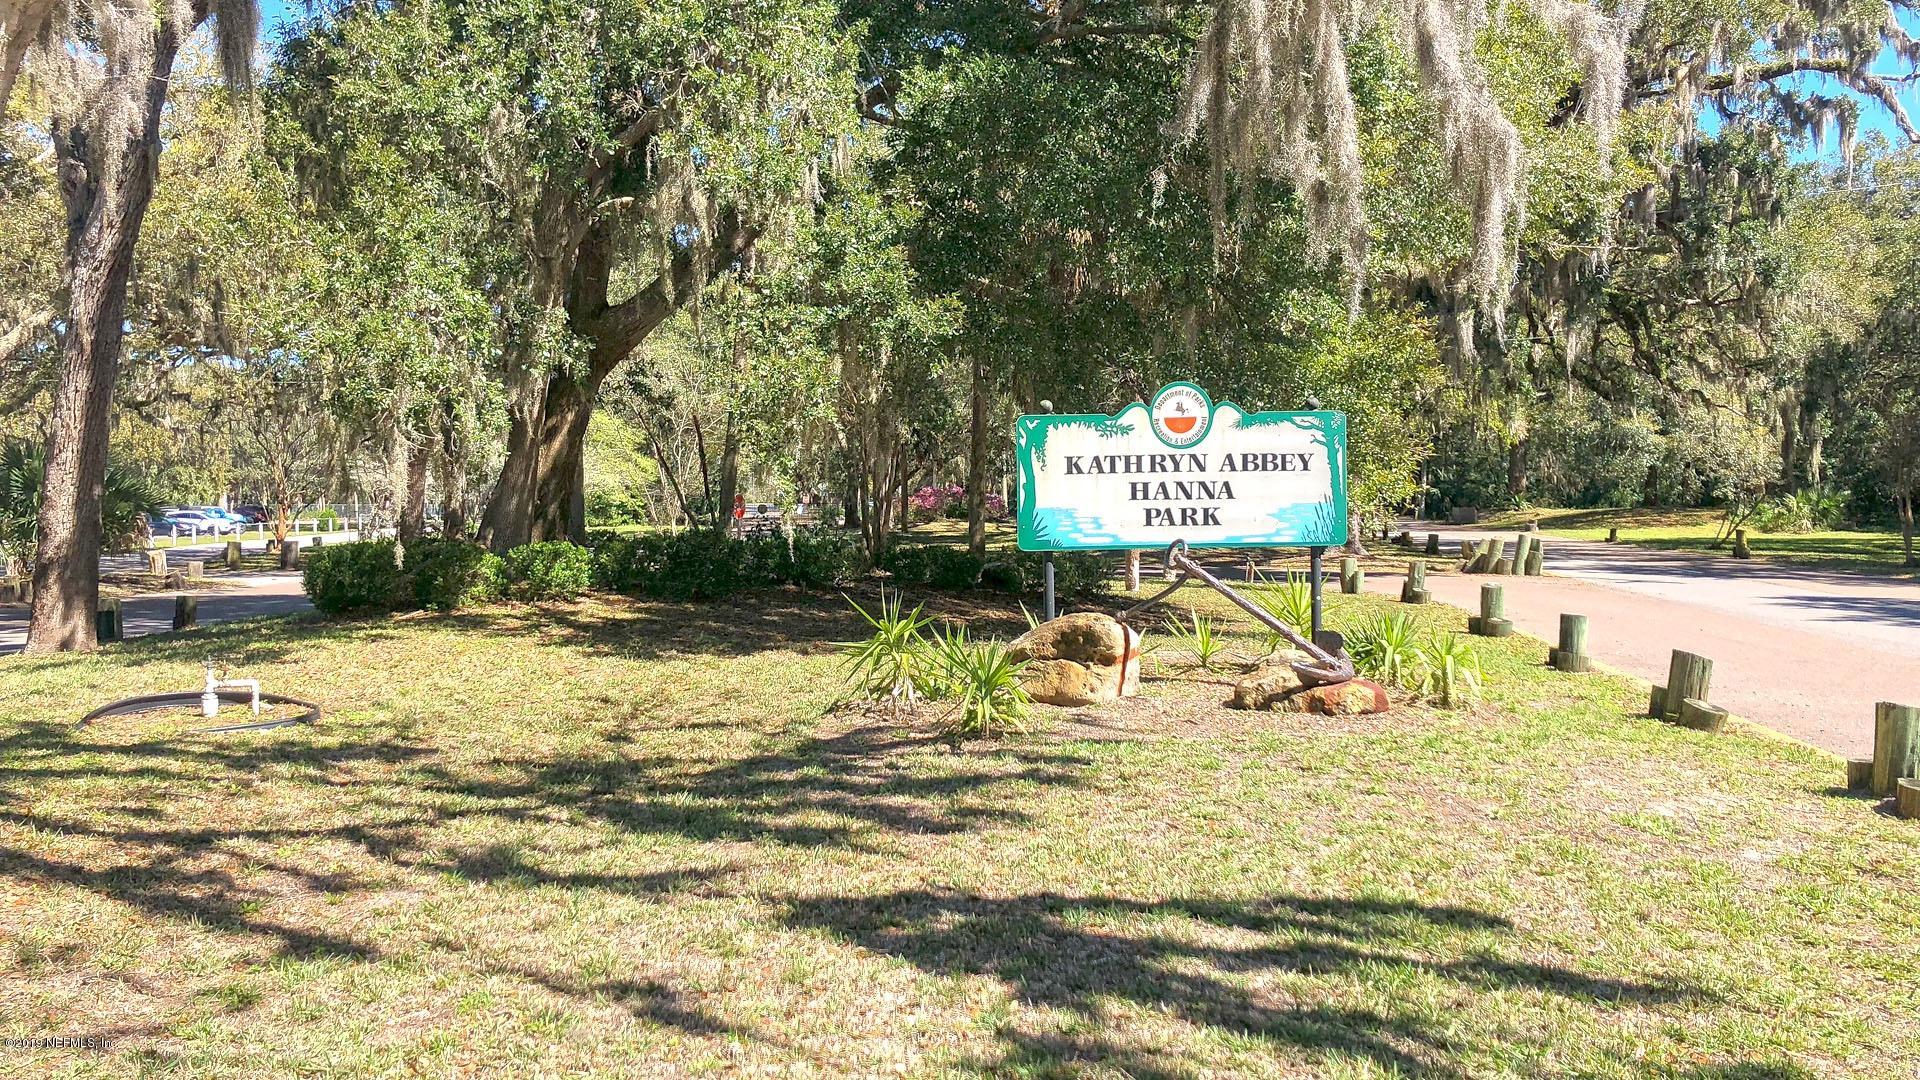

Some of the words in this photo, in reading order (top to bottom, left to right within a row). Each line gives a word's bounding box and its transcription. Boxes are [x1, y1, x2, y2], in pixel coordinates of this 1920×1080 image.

[1155, 389, 1184, 410] Department
[1192, 392, 1205, 408] Parks
[1153, 418, 1173, 443] Recreation
[1180, 416, 1207, 444] Entertainment
[1064, 453, 1209, 475] KATHRYN
[1218, 452, 1314, 473] ABBEY
[1128, 480, 1236, 501] HANNA
[1143, 507, 1222, 527] PARK
